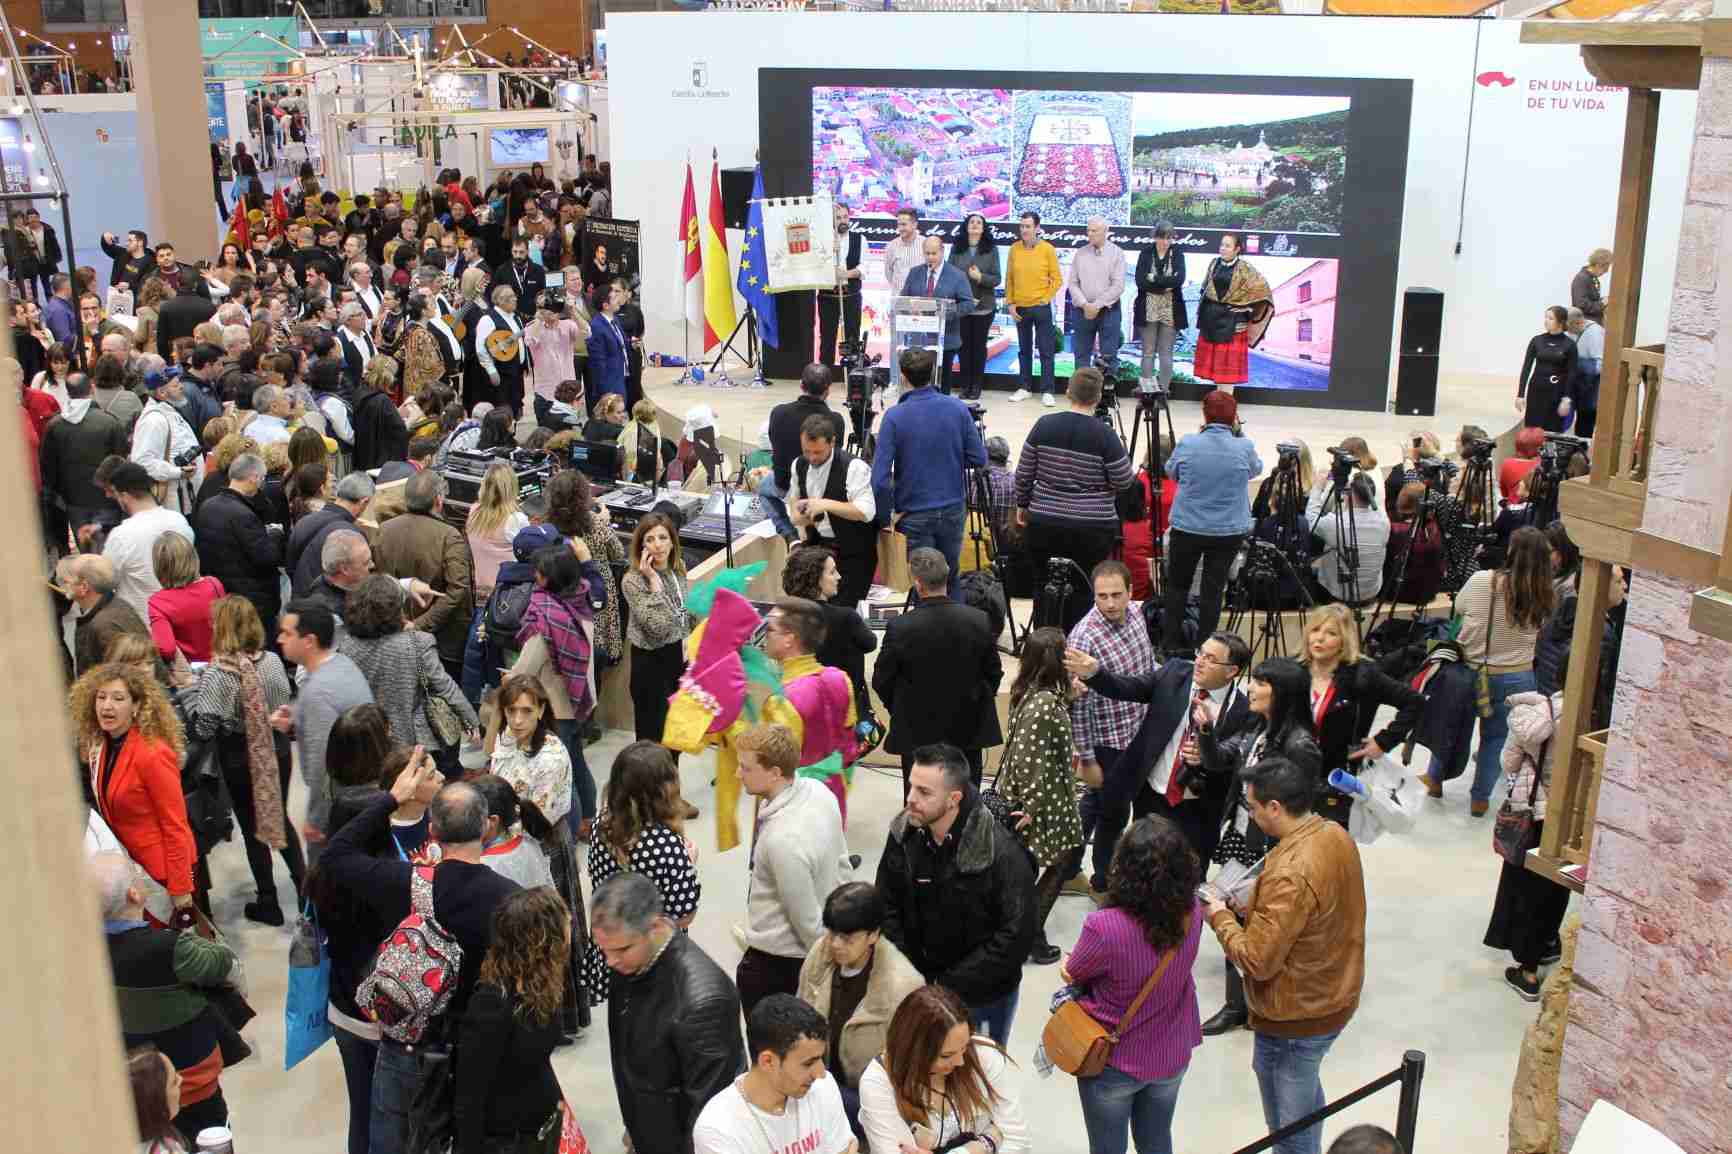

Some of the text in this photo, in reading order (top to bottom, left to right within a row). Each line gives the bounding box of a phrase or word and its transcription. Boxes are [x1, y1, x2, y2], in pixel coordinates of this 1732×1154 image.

[1528, 79, 1548, 91] EN
[1551, 80, 1572, 92] UN
[1527, 98, 1606, 110] DE TU VIDA
